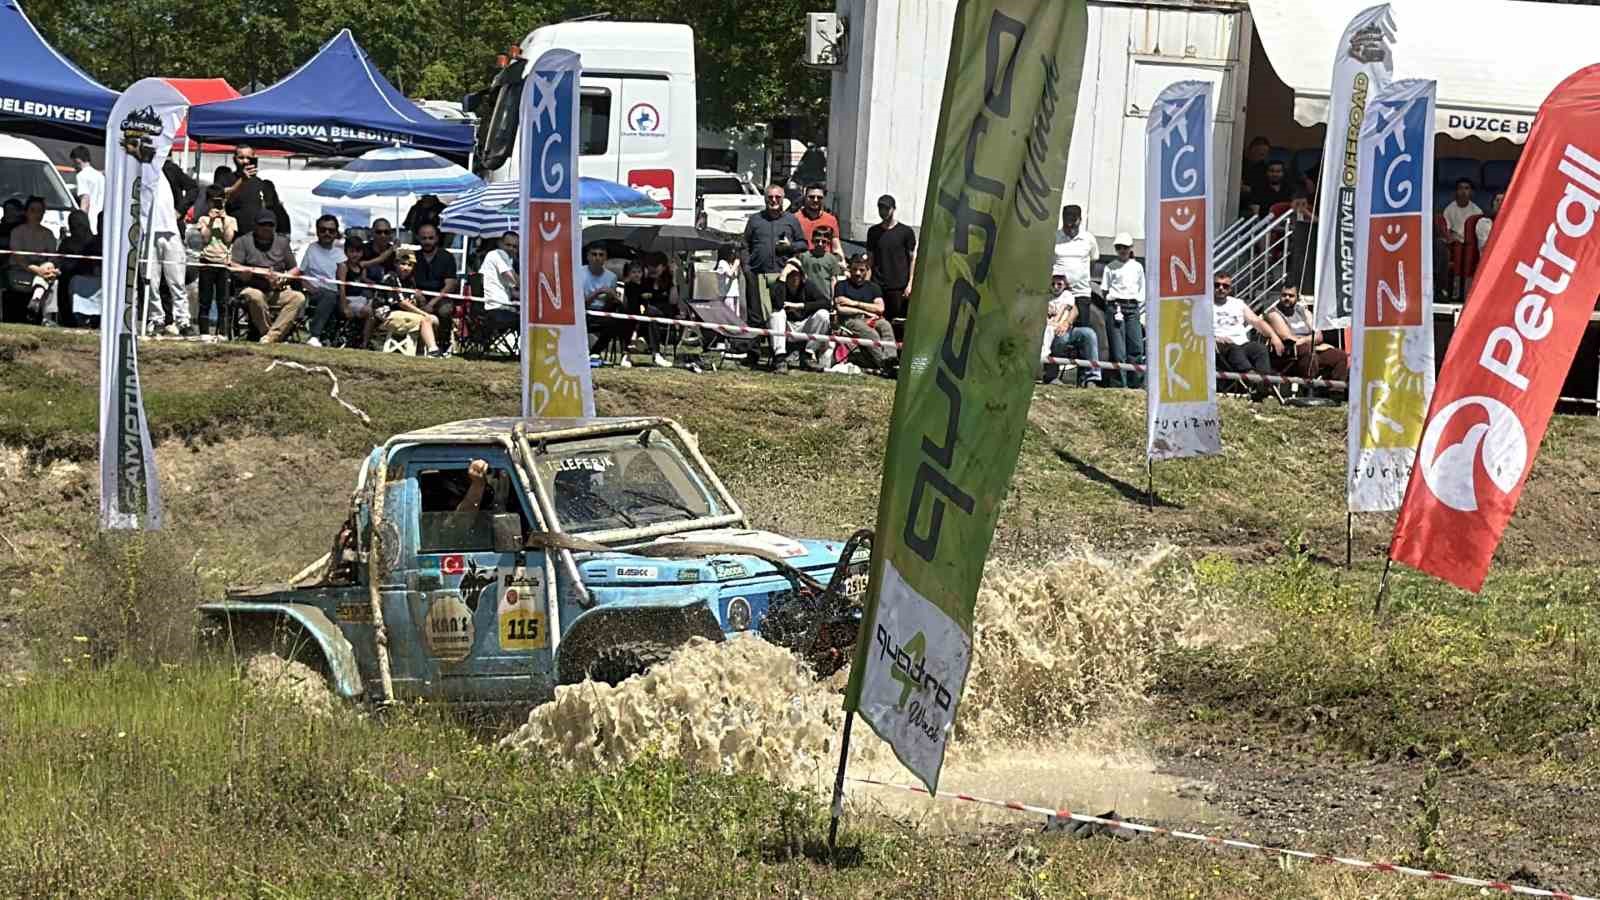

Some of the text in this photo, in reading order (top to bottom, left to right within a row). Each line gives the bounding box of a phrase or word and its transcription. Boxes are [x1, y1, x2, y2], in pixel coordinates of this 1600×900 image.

[1014, 53, 1059, 228] Winch
[1449, 115, 1512, 132] DÜZCE
[1479, 144, 1600, 391] Petrall
[508, 618, 539, 640] 115
